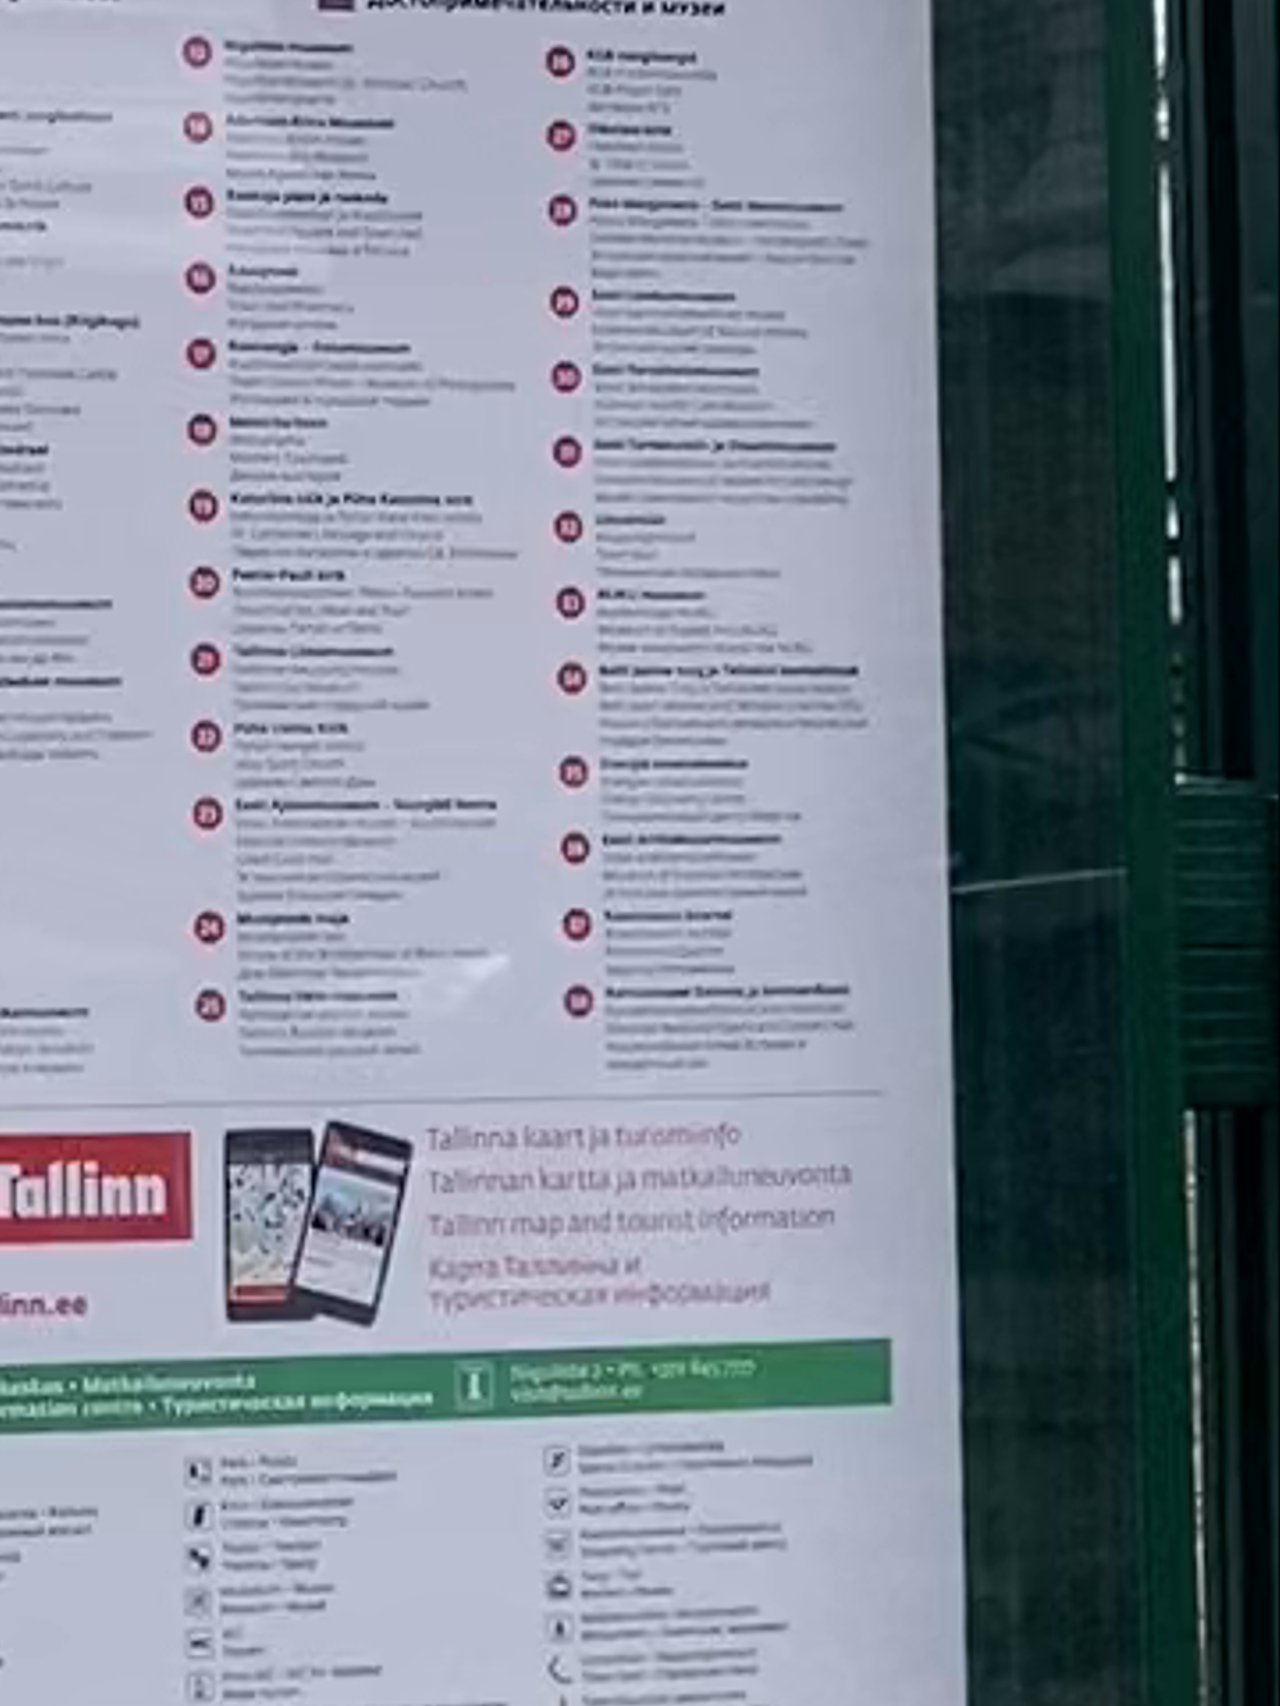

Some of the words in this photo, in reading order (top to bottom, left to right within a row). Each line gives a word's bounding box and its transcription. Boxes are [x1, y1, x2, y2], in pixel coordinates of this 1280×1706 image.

[427, 1127, 517, 1153] Tallinna
[522, 1125, 585, 1151] kaart
[589, 1126, 612, 1153] ja
[429, 1170, 533, 1195] Tallinnan
[540, 1168, 613, 1194] kartta
[616, 1169, 638, 1195] ja
[429, 1213, 506, 1237] Tallinn
[511, 1216, 561, 1239] map
[564, 1212, 613, 1234] and
[617, 1209, 695, 1233] tourist
[698, 1206, 836, 1234] information
